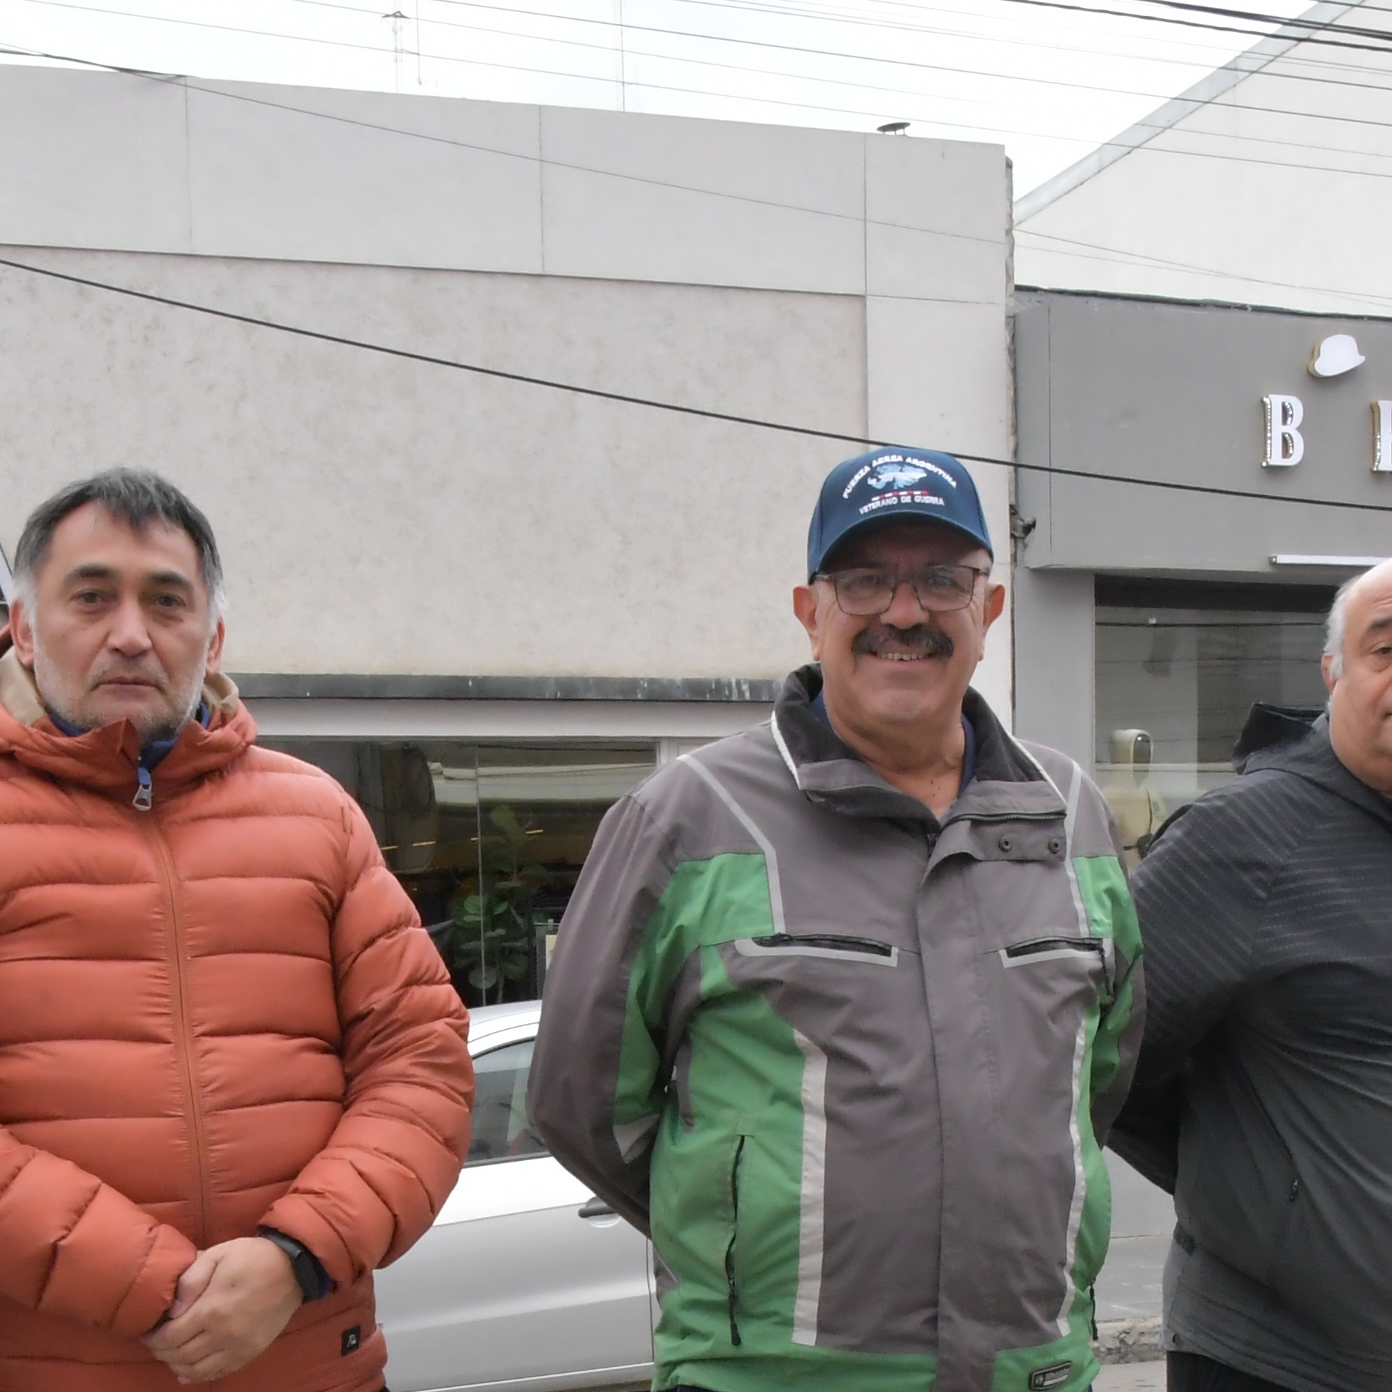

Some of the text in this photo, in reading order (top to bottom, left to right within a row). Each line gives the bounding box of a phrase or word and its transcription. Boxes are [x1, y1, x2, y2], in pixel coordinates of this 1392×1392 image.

[1262, 394, 1305, 468] B
[859, 495, 946, 515] VETERANO DE GUERRA
